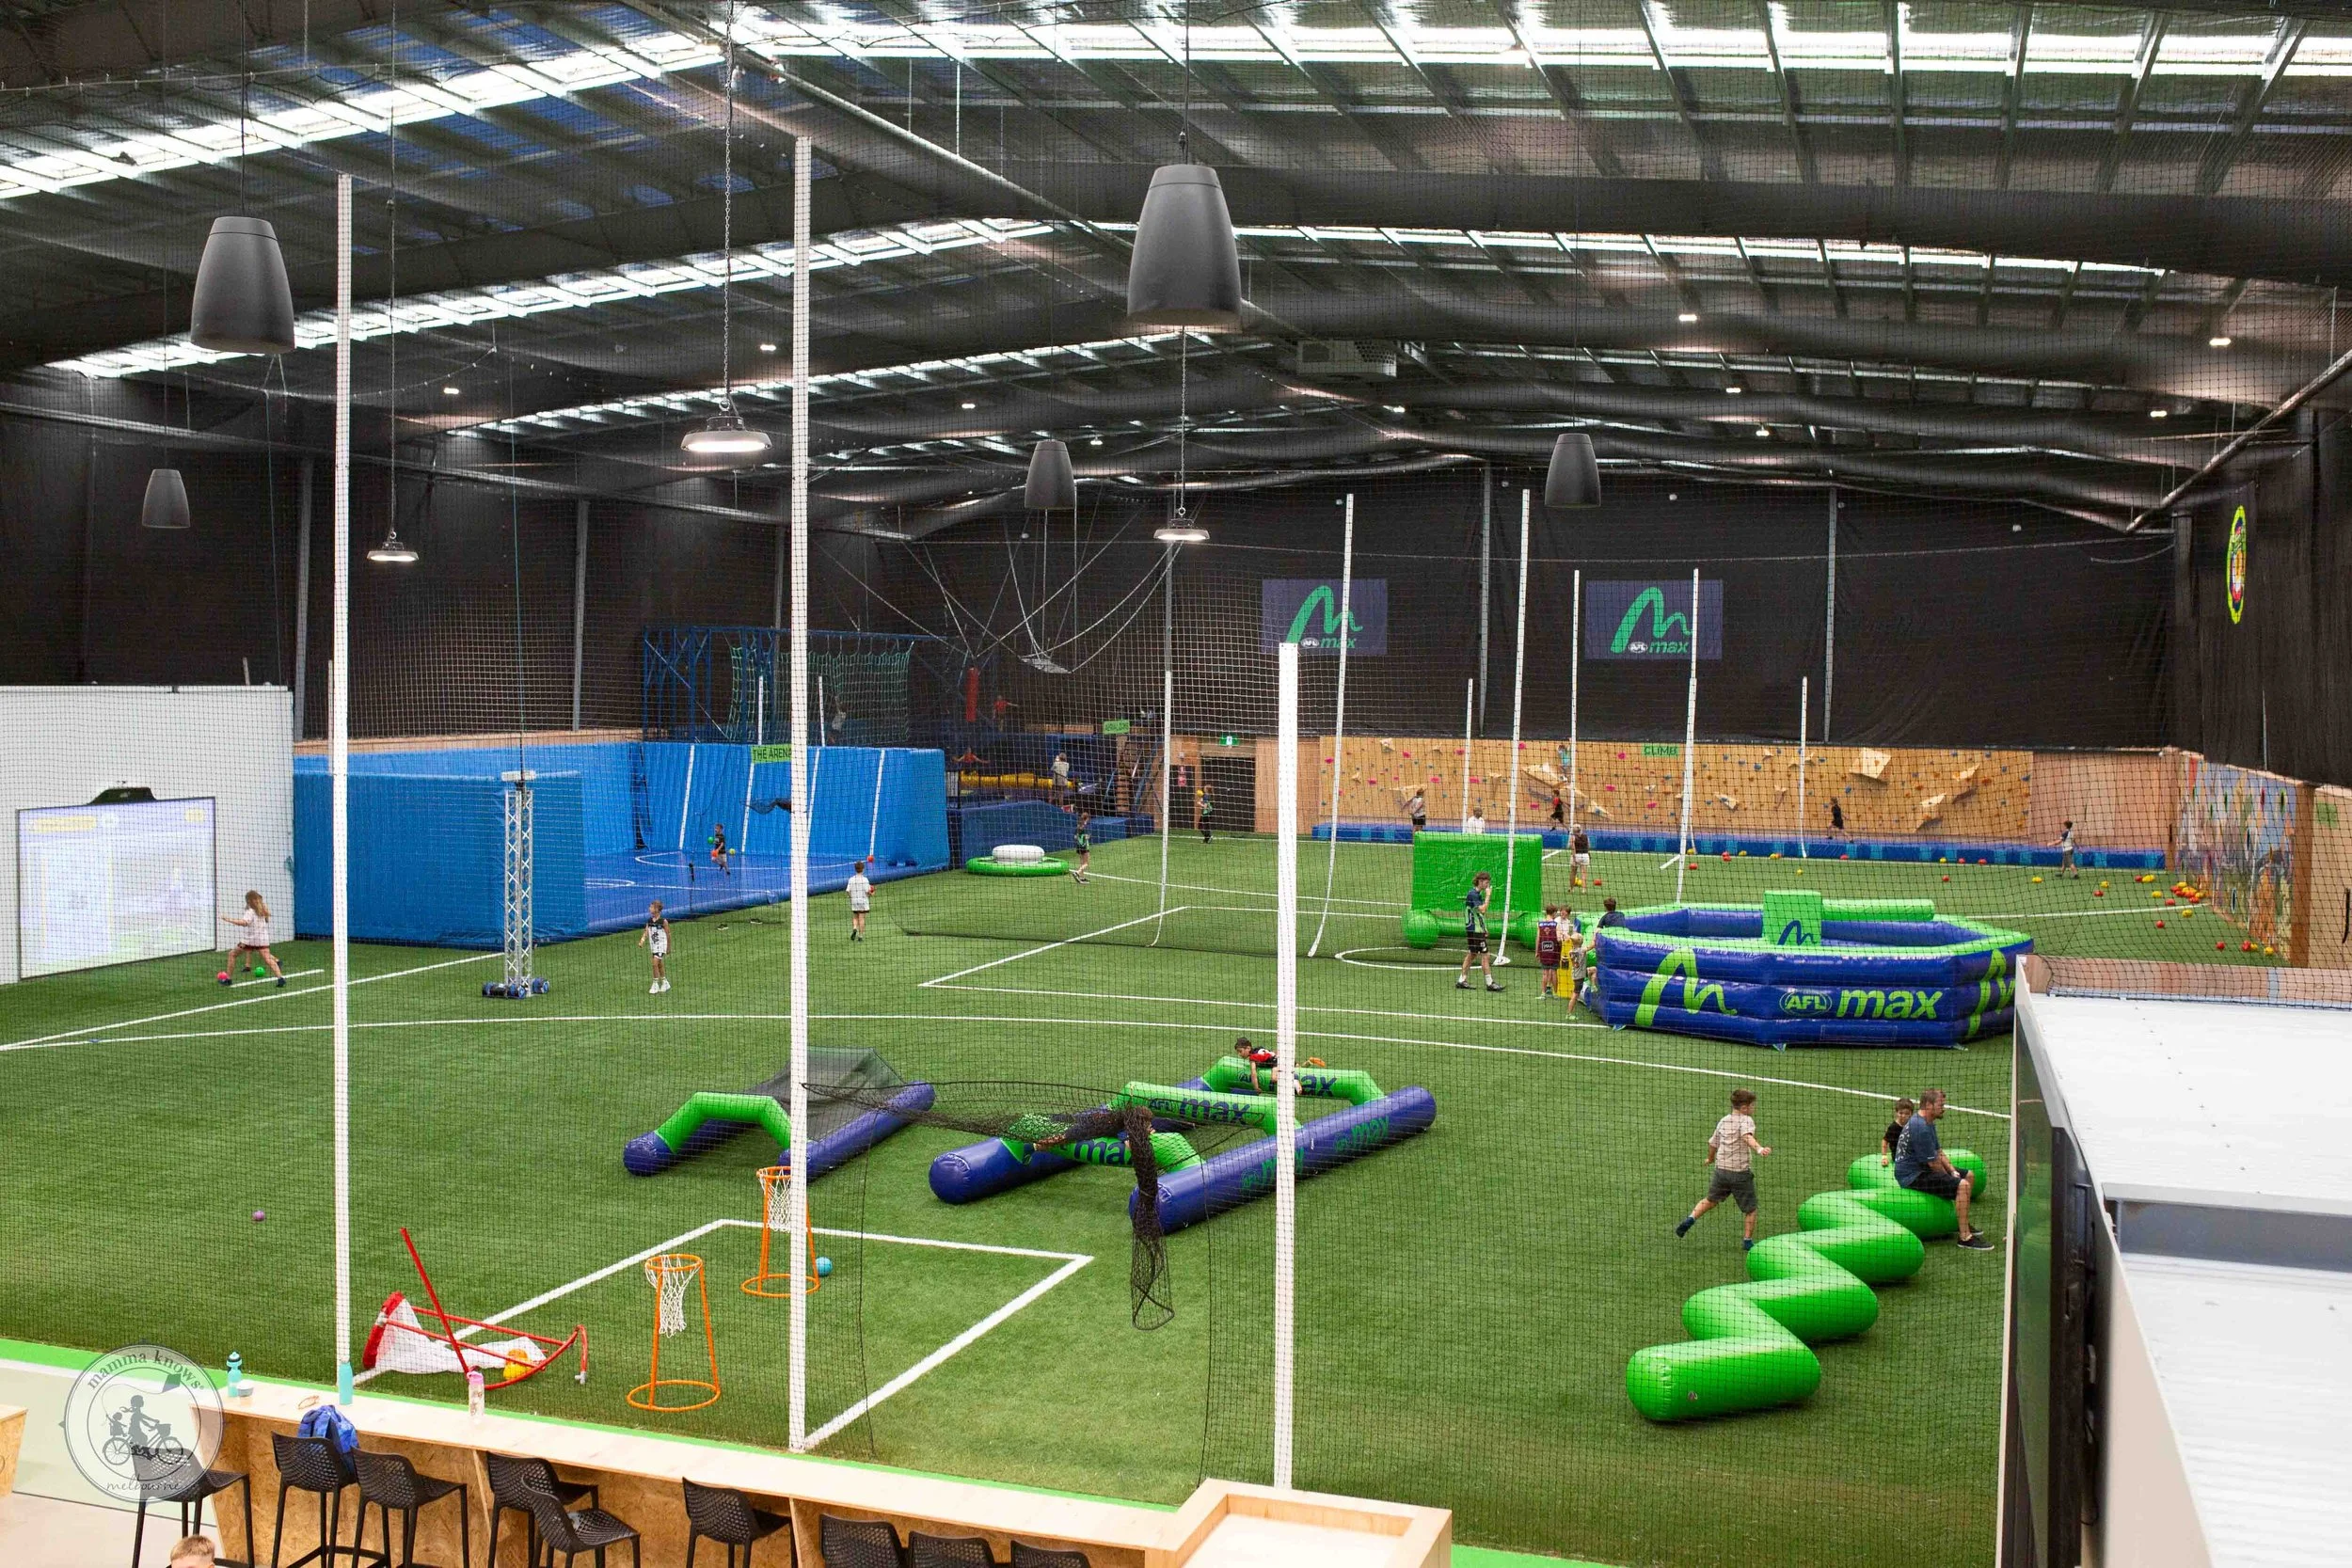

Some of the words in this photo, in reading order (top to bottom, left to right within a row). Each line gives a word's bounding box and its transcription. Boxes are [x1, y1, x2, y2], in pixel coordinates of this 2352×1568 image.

[1648, 641, 1689, 654] max
[754, 749, 767, 759] THE
[1644, 746, 1677, 755] CLIMB
[1785, 994, 1827, 1011] AFL
[1836, 990, 1943, 1020] max
[1295, 1074, 1338, 1097] ax
[1179, 1097, 1251, 1125] max
[1073, 1140, 1133, 1164] ma
